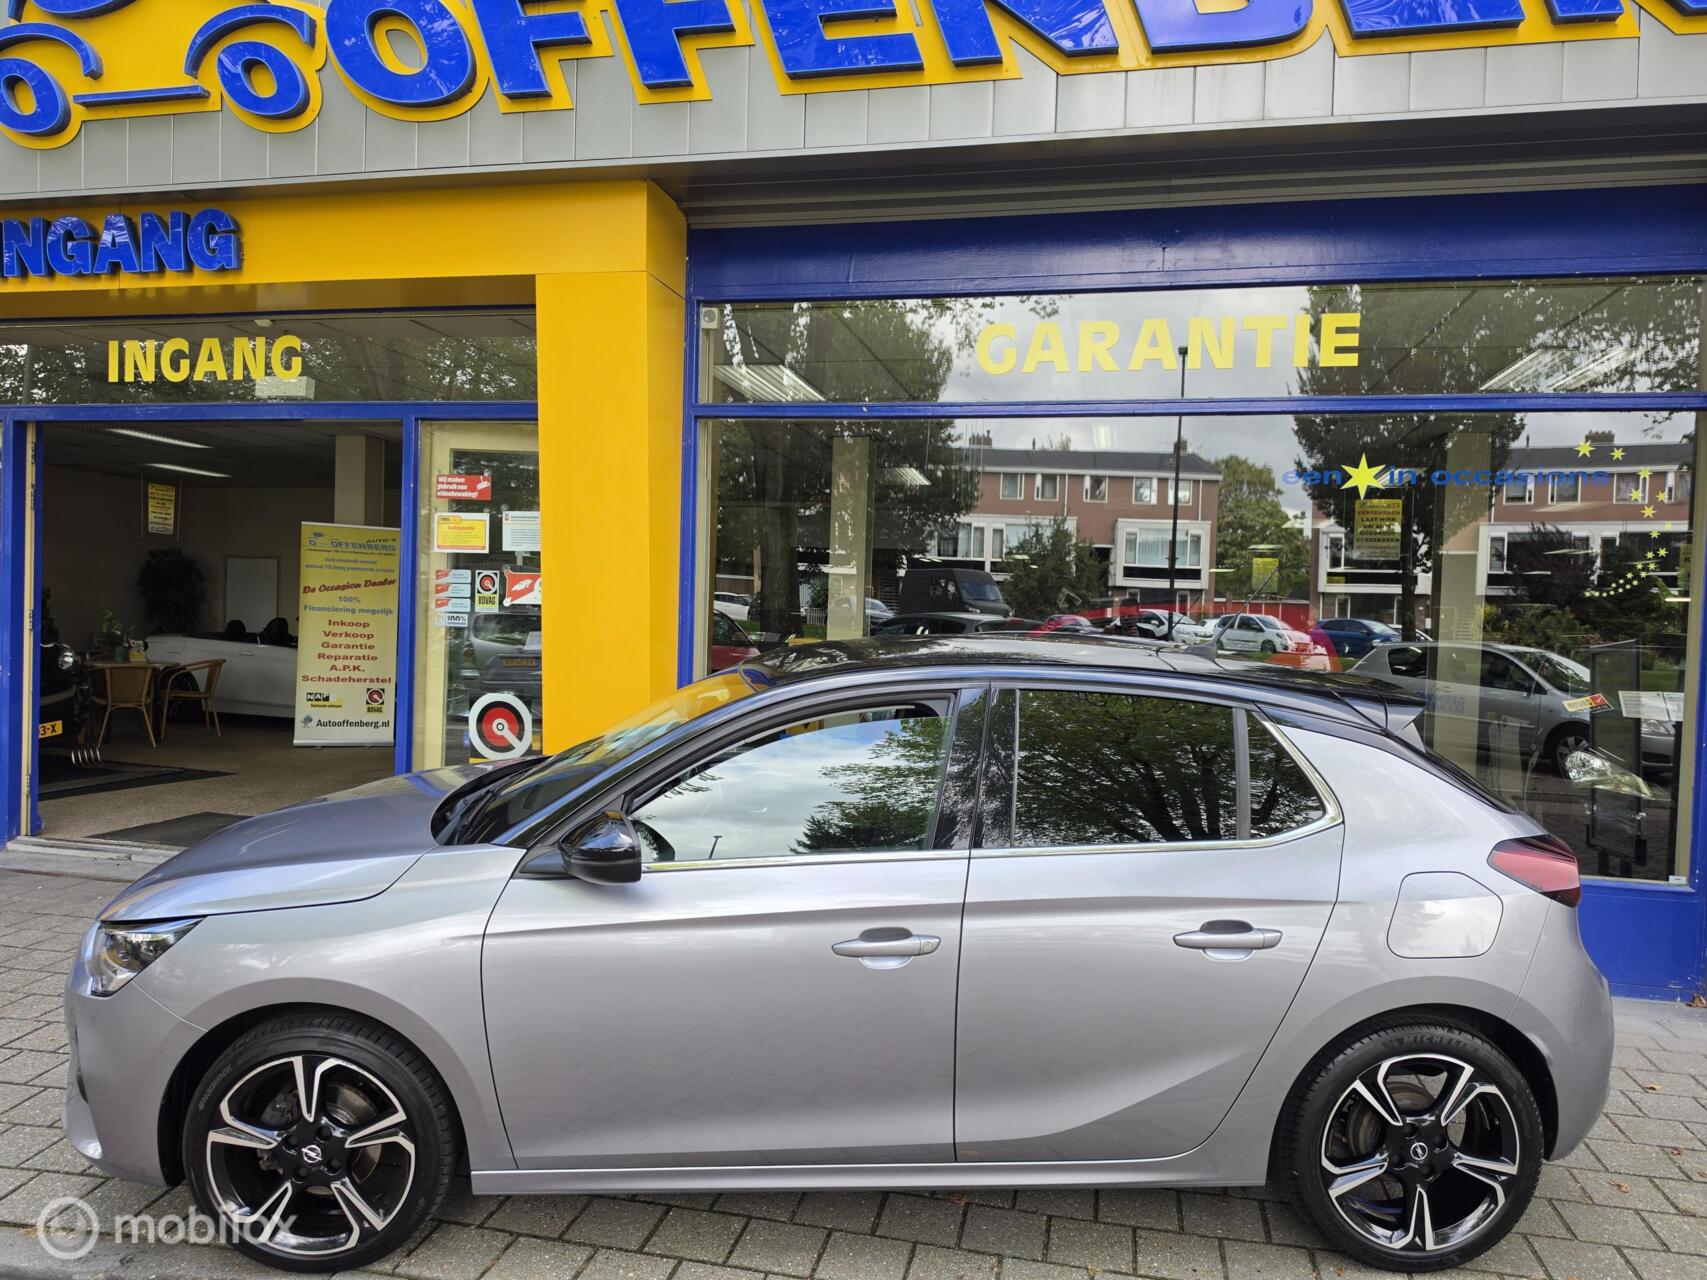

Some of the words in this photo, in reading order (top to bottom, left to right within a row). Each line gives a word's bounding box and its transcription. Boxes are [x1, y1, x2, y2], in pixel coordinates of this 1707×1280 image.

[976, 312, 1361, 374] GARANTIE
[108, 335, 302, 383] INGANG
[1282, 469, 1342, 486] een
[1388, 466, 1416, 485] in
[1431, 466, 1609, 487] occasions
[302, 586, 316, 594] De
[318, 582, 361, 593] Occasion
[478, 595, 496, 605] BOVAG
[303, 605, 356, 614] Financiering
[358, 608, 394, 616] mogelijk
[328, 619, 370, 629] Inkoop
[323, 630, 375, 640] Verkoop
[321, 642, 375, 650] Garantie
[317, 652, 378, 662] Reparatie
[329, 664, 365, 672] A.P.K.
[301, 675, 392, 684] Schadeherstel
[316, 719, 390, 729] Autooffenberg.nl
